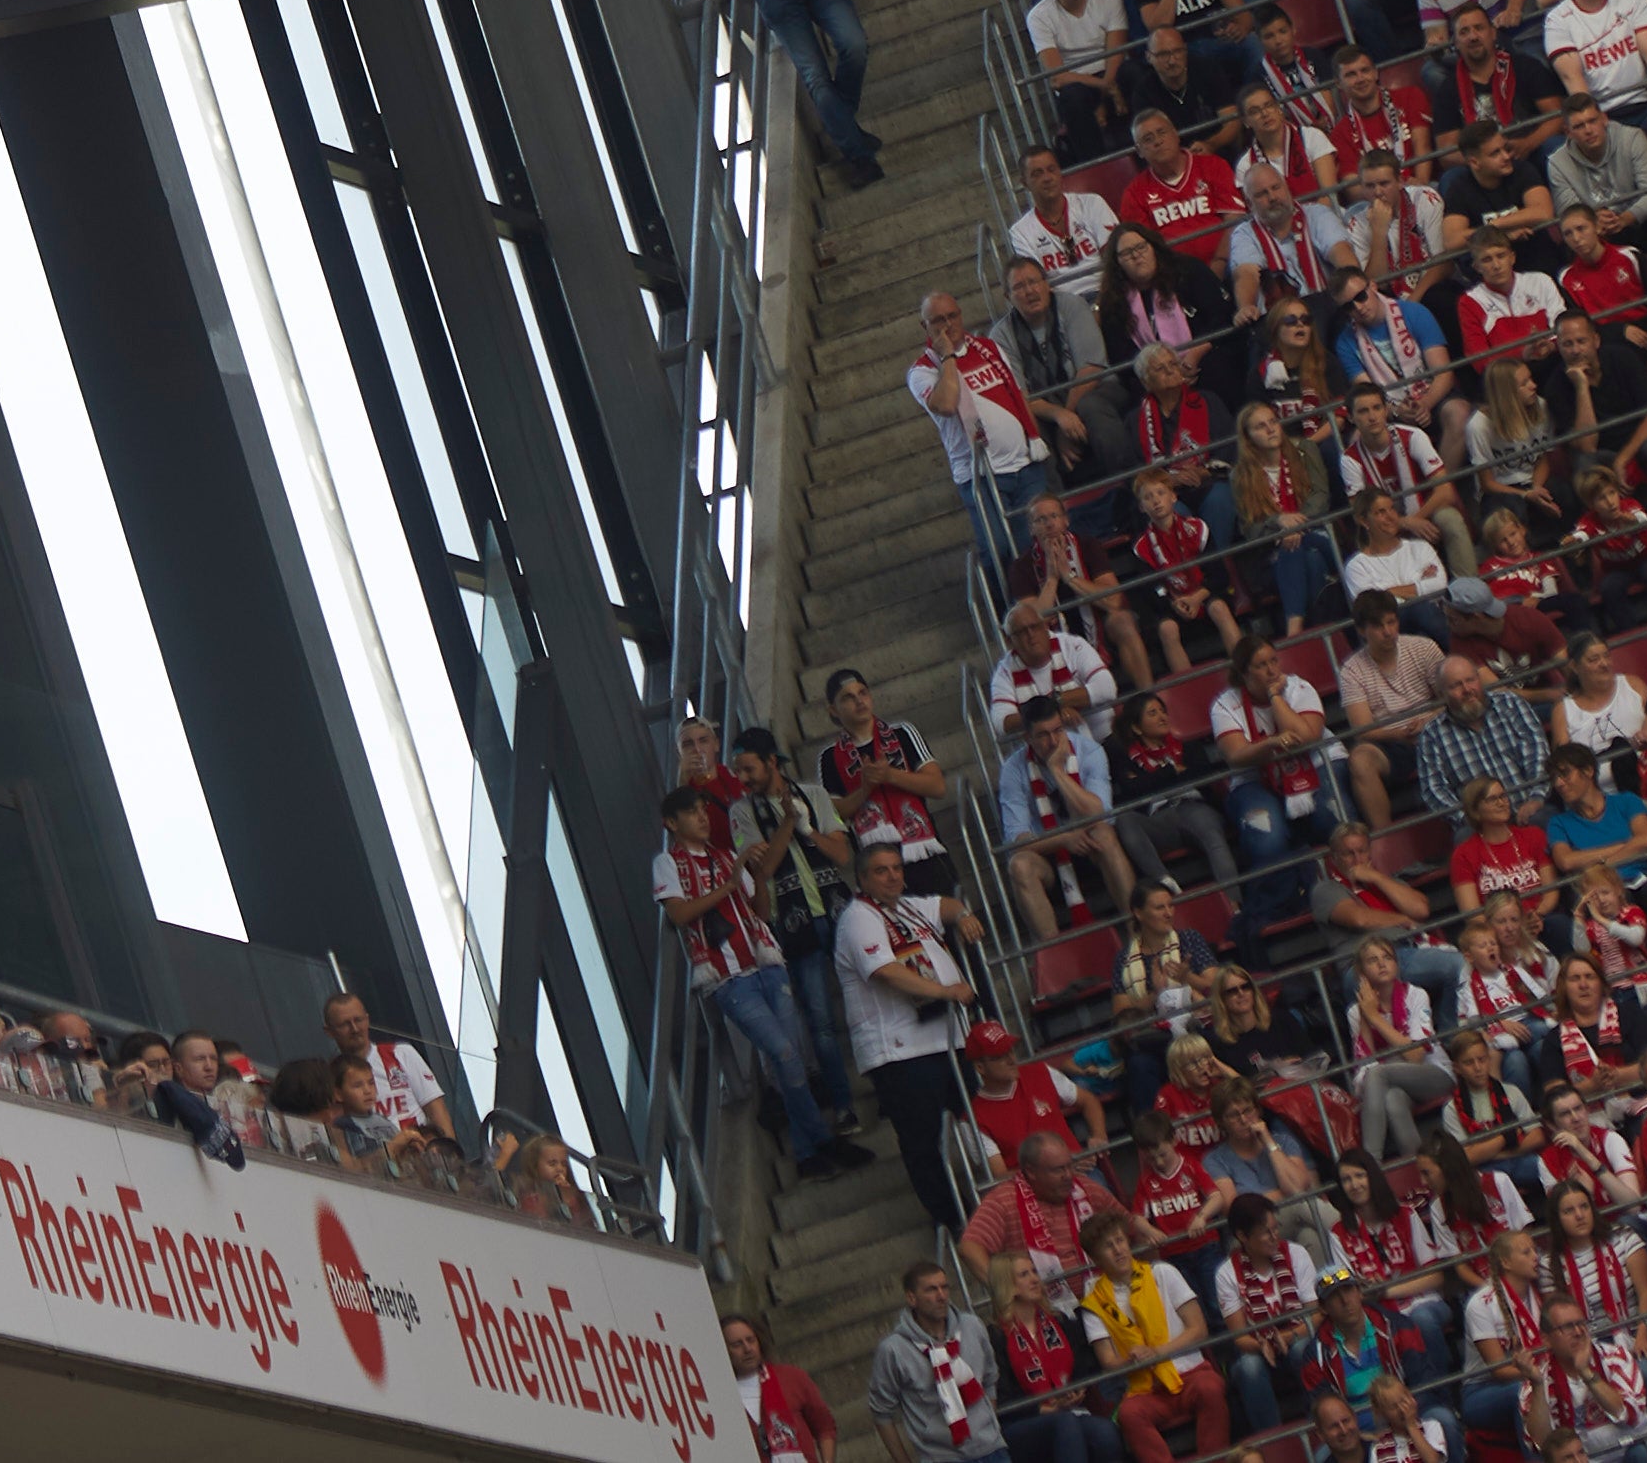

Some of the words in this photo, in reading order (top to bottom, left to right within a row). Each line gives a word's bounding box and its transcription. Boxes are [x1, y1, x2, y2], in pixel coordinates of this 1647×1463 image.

[1586, 35, 1637, 71] REWE
[1153, 195, 1211, 227] REWE
[1041, 237, 1097, 269] REWE
[966, 365, 1002, 391] EW
[374, 1094, 410, 1117] WE
[1179, 1124, 1221, 1148] REW
[1149, 1189, 1202, 1216] REWE
[324, 1263, 422, 1333] RheinEnergie
[438, 1259, 717, 1463] RheinEnergie
